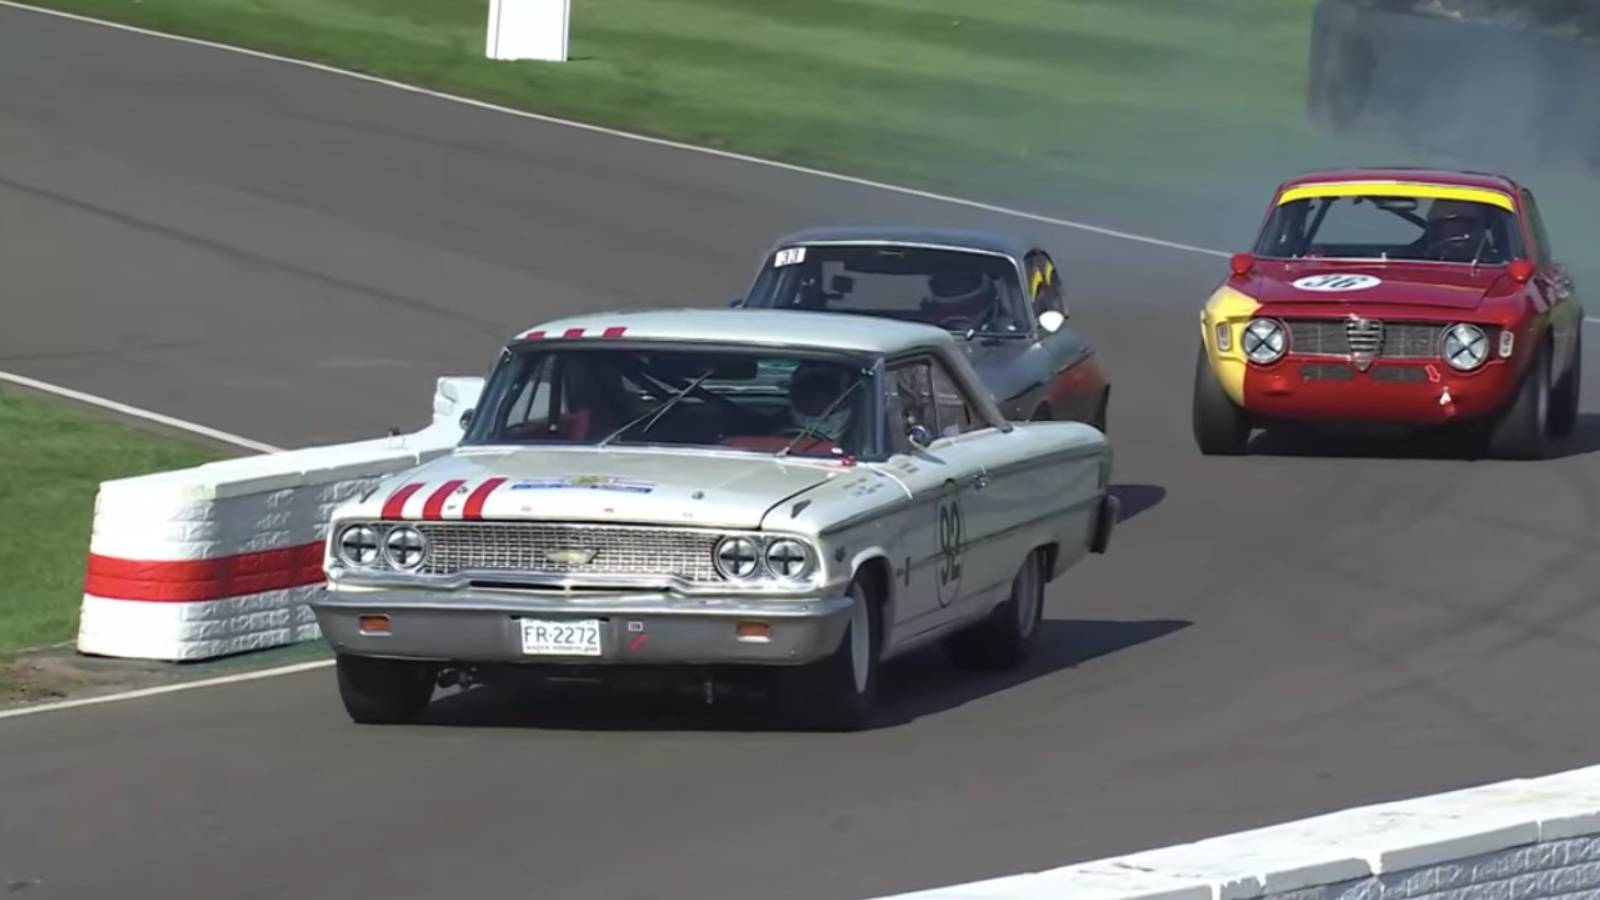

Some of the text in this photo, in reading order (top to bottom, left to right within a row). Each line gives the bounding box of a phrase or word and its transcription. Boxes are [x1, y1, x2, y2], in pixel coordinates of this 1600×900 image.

[780, 249, 800, 266] 33
[1302, 275, 1369, 289] 36
[940, 501, 960, 586] 92
[523, 625, 598, 645] FR-2272
